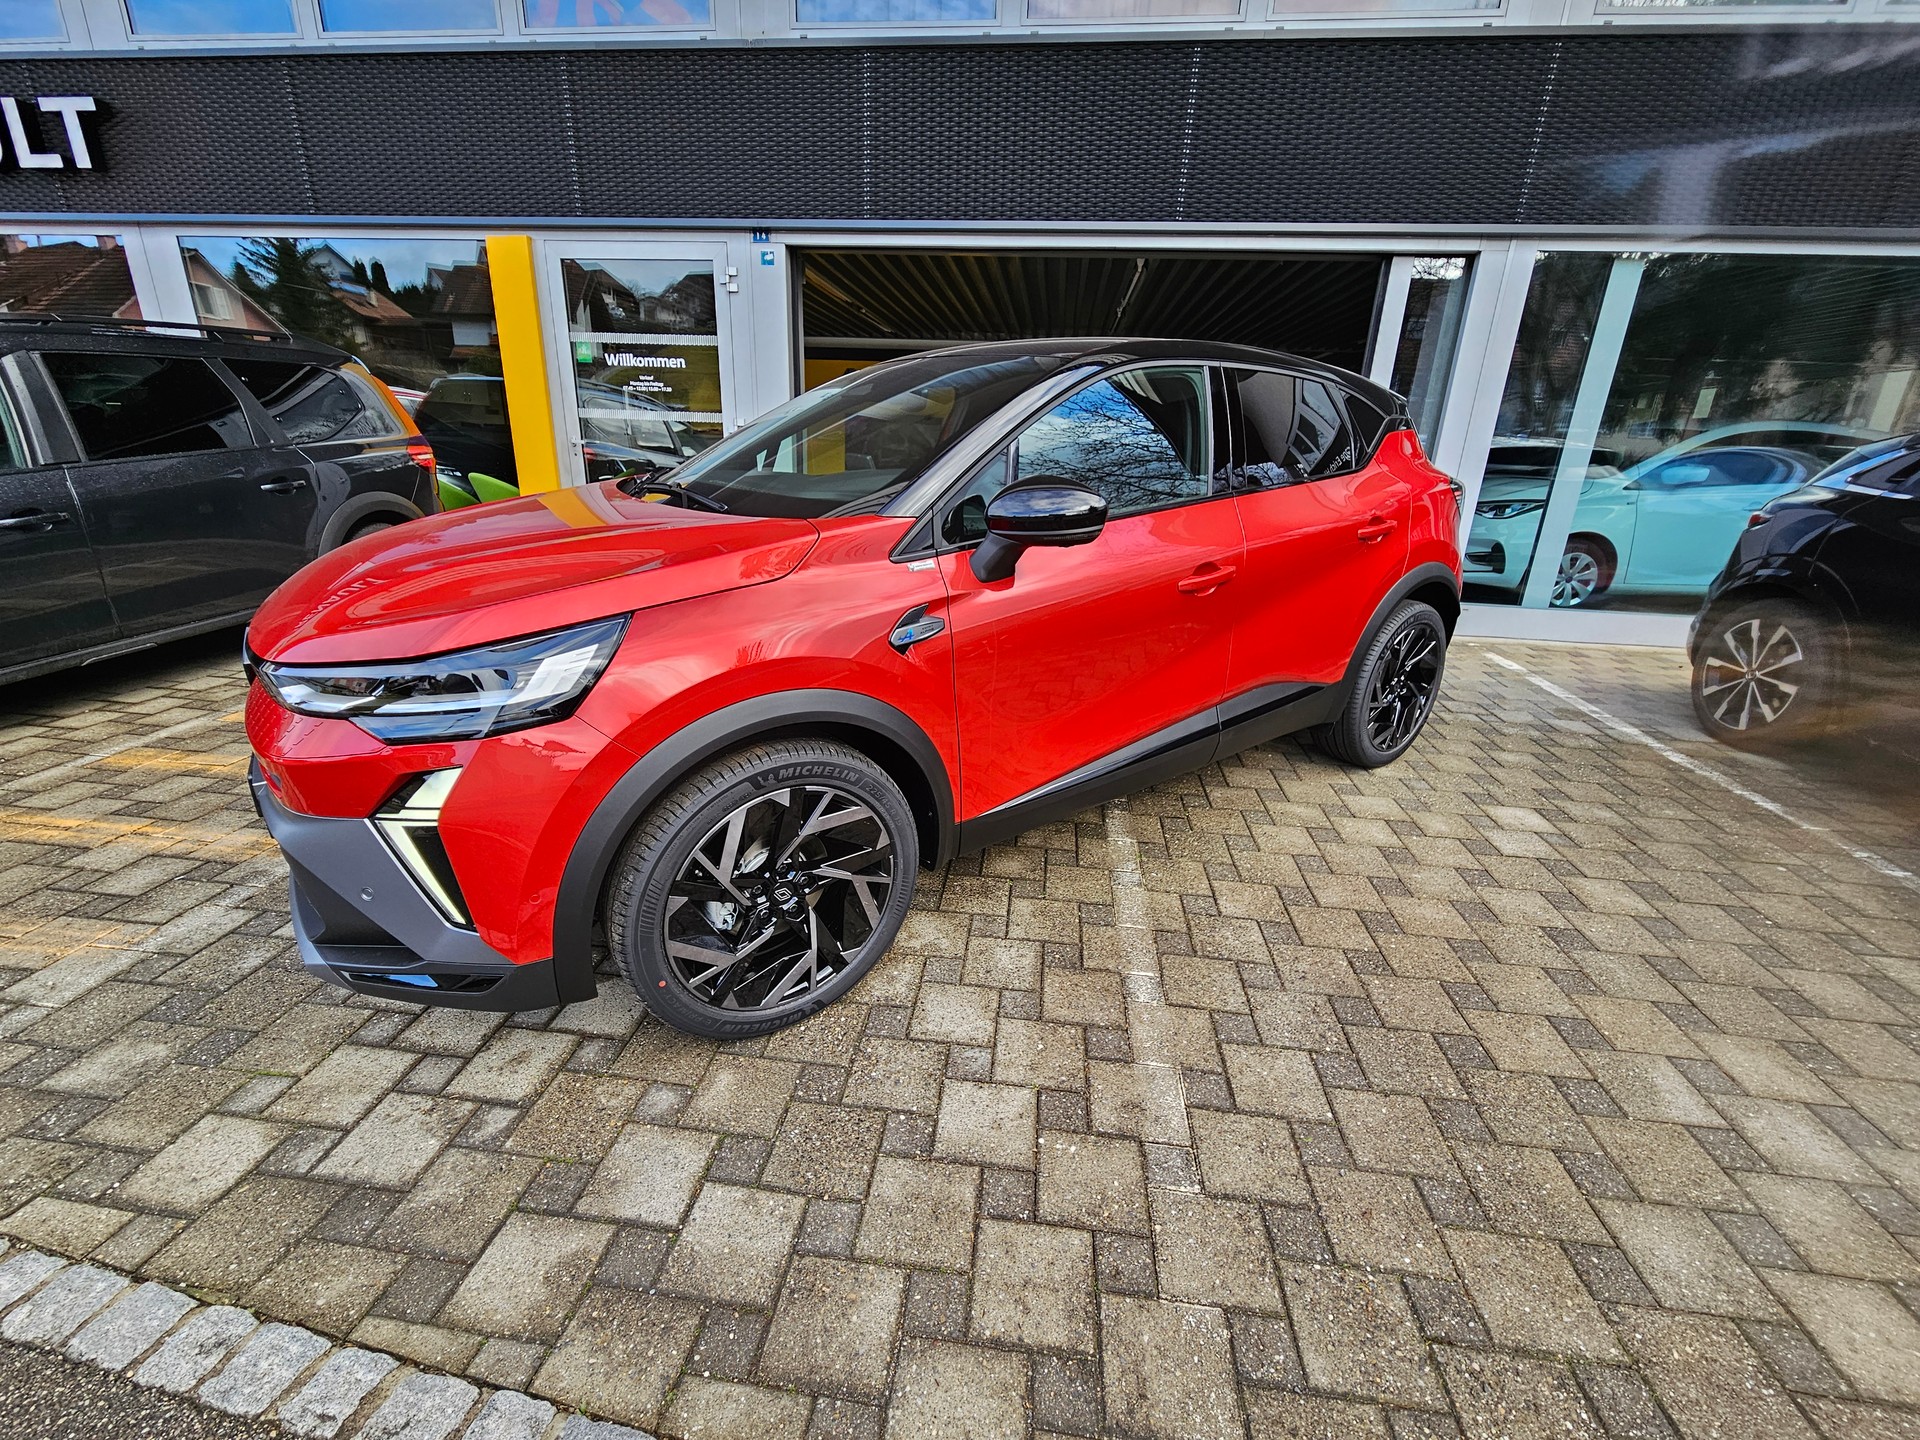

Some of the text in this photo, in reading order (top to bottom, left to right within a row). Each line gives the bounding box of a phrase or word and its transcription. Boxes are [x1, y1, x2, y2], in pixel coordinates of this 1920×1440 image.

[0, 97, 96, 169] LT
[604, 353, 686, 368] Willkommen
[779, 765, 859, 782] MICHELIN
[865, 784, 891, 809] 225/45
[720, 1011, 803, 1033] MICHELIN
